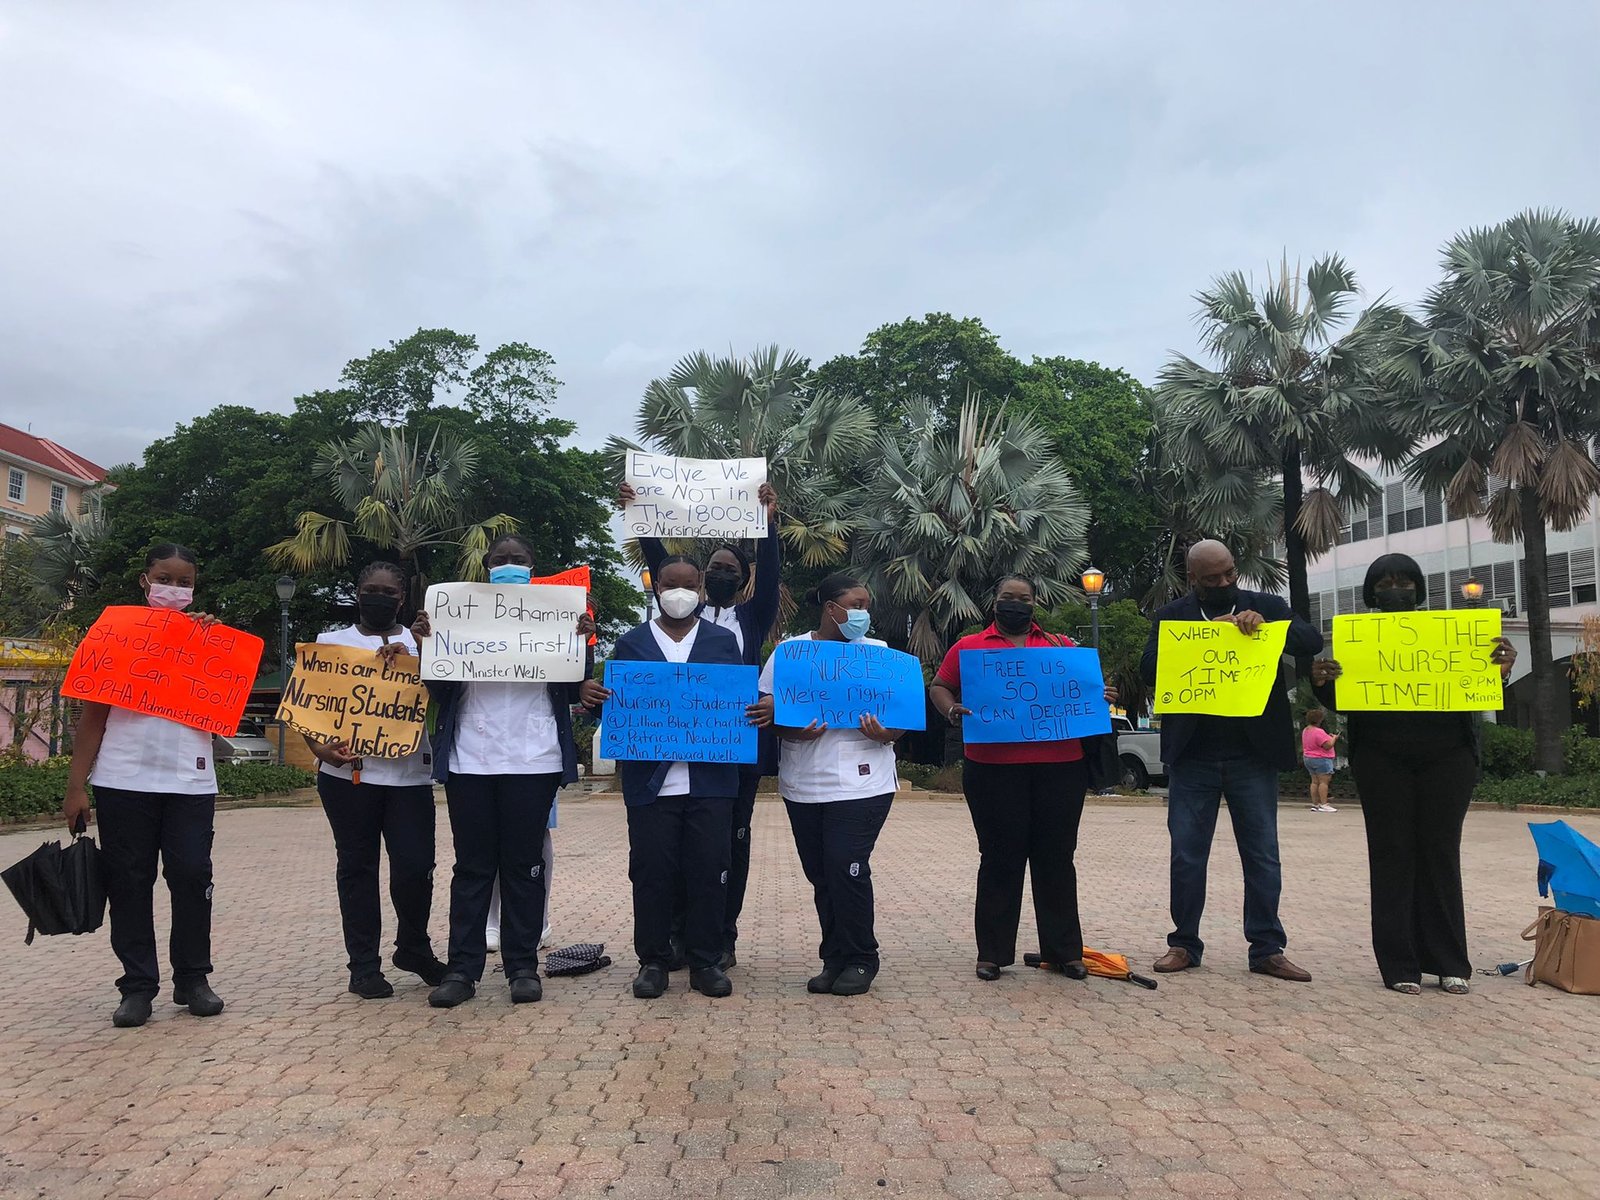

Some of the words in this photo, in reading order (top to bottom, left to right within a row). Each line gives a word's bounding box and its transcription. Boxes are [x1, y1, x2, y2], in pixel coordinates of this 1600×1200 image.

[633, 453, 707, 483] Evolve
[721, 461, 750, 481] We
[635, 485, 665, 497] are
[672, 484, 722, 503] NOT
[729, 487, 748, 502] in
[633, 504, 678, 522] The
[435, 591, 479, 620] Put
[494, 593, 580, 622] Bahamian
[135, 609, 186, 632] If
[188, 618, 235, 654] Med
[1168, 626, 1220, 642] WHEN
[1252, 629, 1269, 642] IS
[1344, 616, 1419, 646] IT'S
[1432, 616, 1490, 647] THE
[435, 630, 508, 657] Nurses
[519, 632, 579, 663] First!!
[783, 642, 821, 660] WHY
[1203, 649, 1240, 665] OUR
[204, 655, 249, 690] Can,
[302, 651, 333, 674] When
[335, 657, 349, 675] is
[351, 664, 377, 678] our
[462, 660, 509, 678] Minister
[513, 664, 546, 680] Wells
[982, 651, 1027, 678] FREE
[1378, 649, 1488, 673] NURSES
[80, 643, 114, 673] We
[129, 657, 170, 687] Can
[183, 674, 240, 710] Too!!
[609, 663, 656, 685] Free
[673, 666, 709, 685] the
[1476, 676, 1496, 687] PM
[610, 687, 671, 714] Nursing
[779, 684, 831, 704] We're
[848, 685, 895, 703] right
[1002, 680, 1038, 701] SO
[1179, 688, 1216, 704] OPM
[1356, 681, 1450, 710] TIME!!!
[1465, 691, 1502, 703] Minnis
[137, 692, 233, 735] Administration
[284, 677, 348, 730] Nursing
[350, 684, 426, 723] Students
[980, 705, 1015, 723] CAN
[1029, 702, 1096, 721] DEGREE
[685, 730, 742, 745] Newbold
